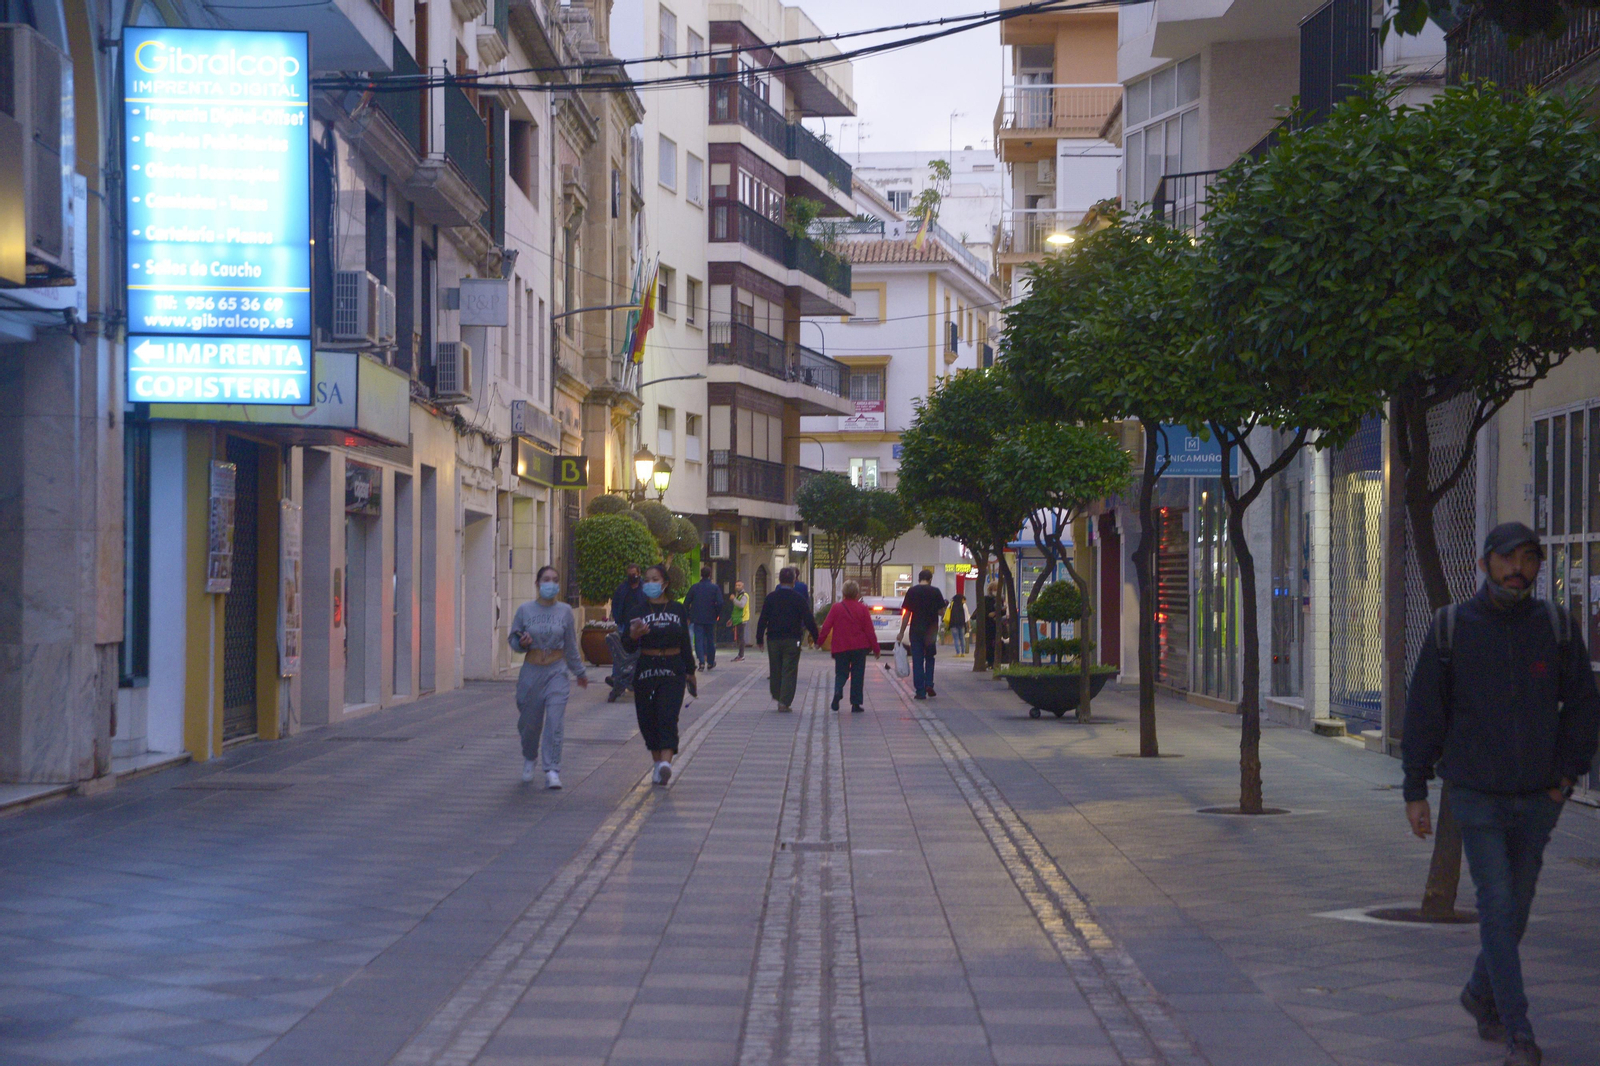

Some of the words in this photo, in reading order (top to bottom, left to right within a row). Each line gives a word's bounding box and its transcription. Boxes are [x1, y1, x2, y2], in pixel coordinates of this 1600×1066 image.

[134, 40, 300, 82] Gibralcop
[133, 80, 224, 95] IMPRENTA
[229, 82, 300, 98] DIGITAL
[145, 106, 206, 125] Imprenta
[210, 107, 305, 128] Digital-Offset
[226, 227, 273, 244] Planos
[145, 259, 187, 276] Sellos
[189, 262, 207, 277] de
[210, 261, 262, 278] Caucho
[185, 296, 215, 311] 956
[218, 297, 236, 311] 65
[241, 297, 260, 311] 36
[263, 298, 283, 312] 69
[467, 294, 499, 311] P&P
[143, 313, 294, 331] www.gibralcop.es
[167, 342, 303, 366] IMPRENTA
[135, 375, 301, 399] COPISTERIA
[561, 459, 580, 482] B
